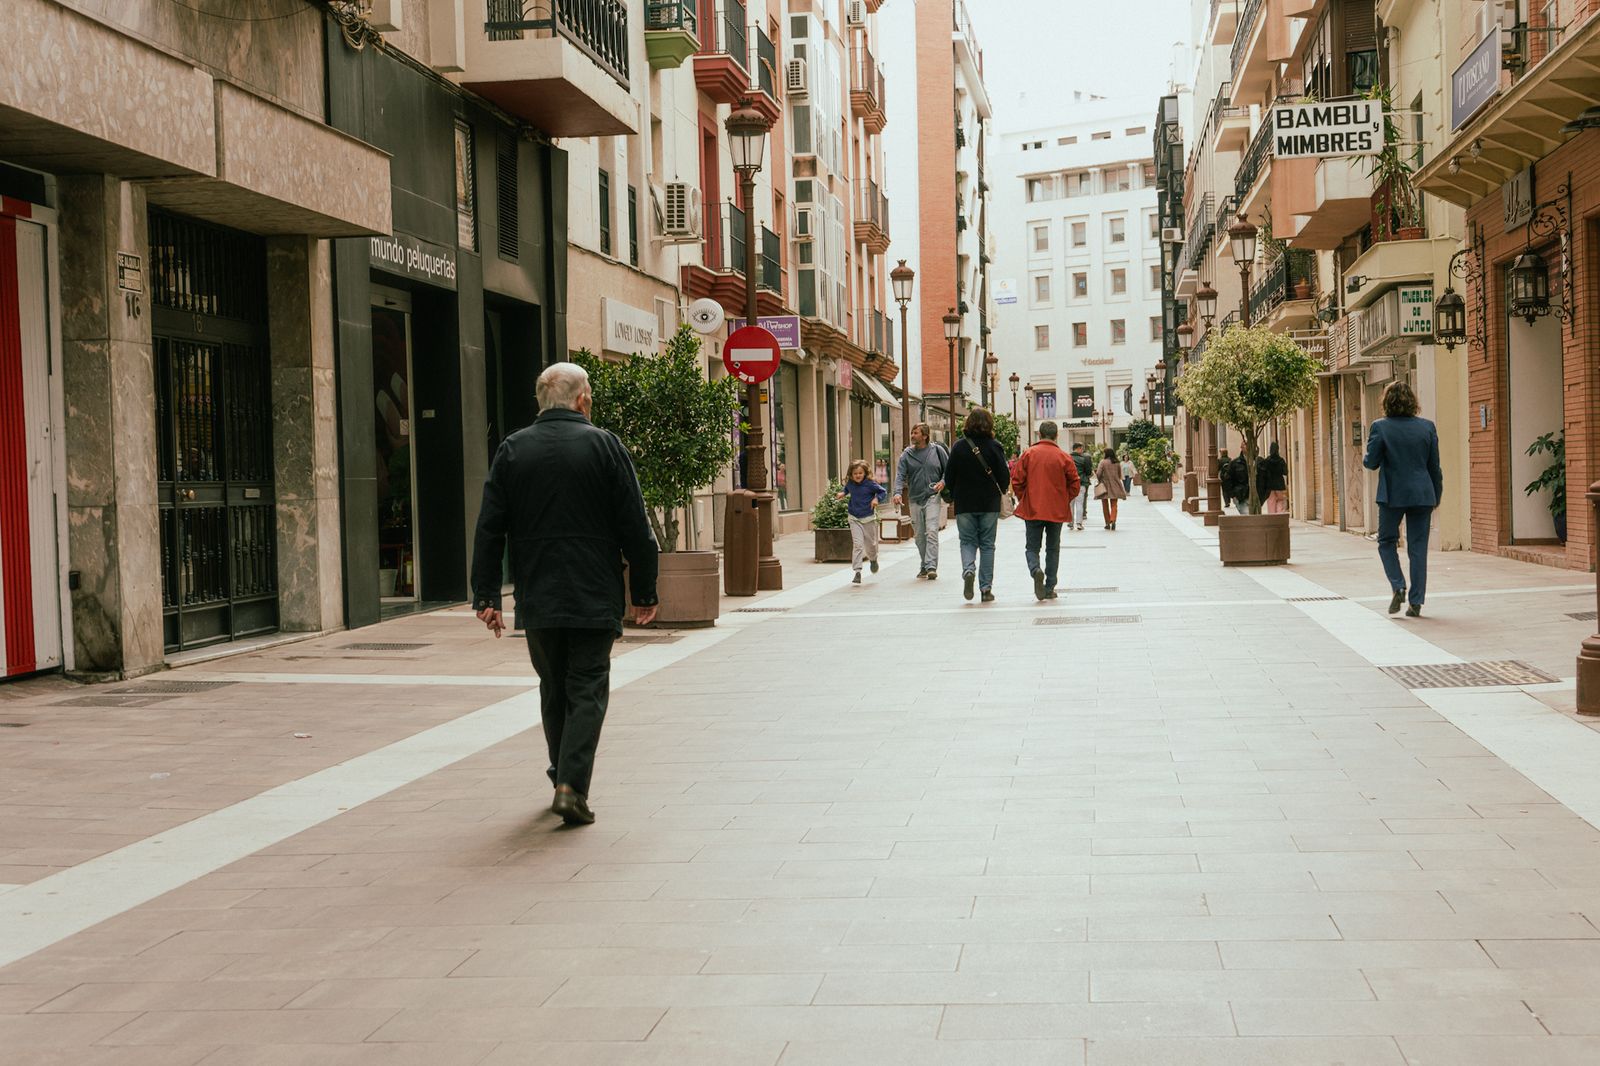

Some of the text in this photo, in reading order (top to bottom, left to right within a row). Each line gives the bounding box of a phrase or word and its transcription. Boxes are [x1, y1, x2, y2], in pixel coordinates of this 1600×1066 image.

[1276, 104, 1371, 129] BAMBU
[1277, 131, 1372, 156] MIMBRES
[371, 237, 456, 279] mundo peluquerías
[125, 293, 141, 319] 16
